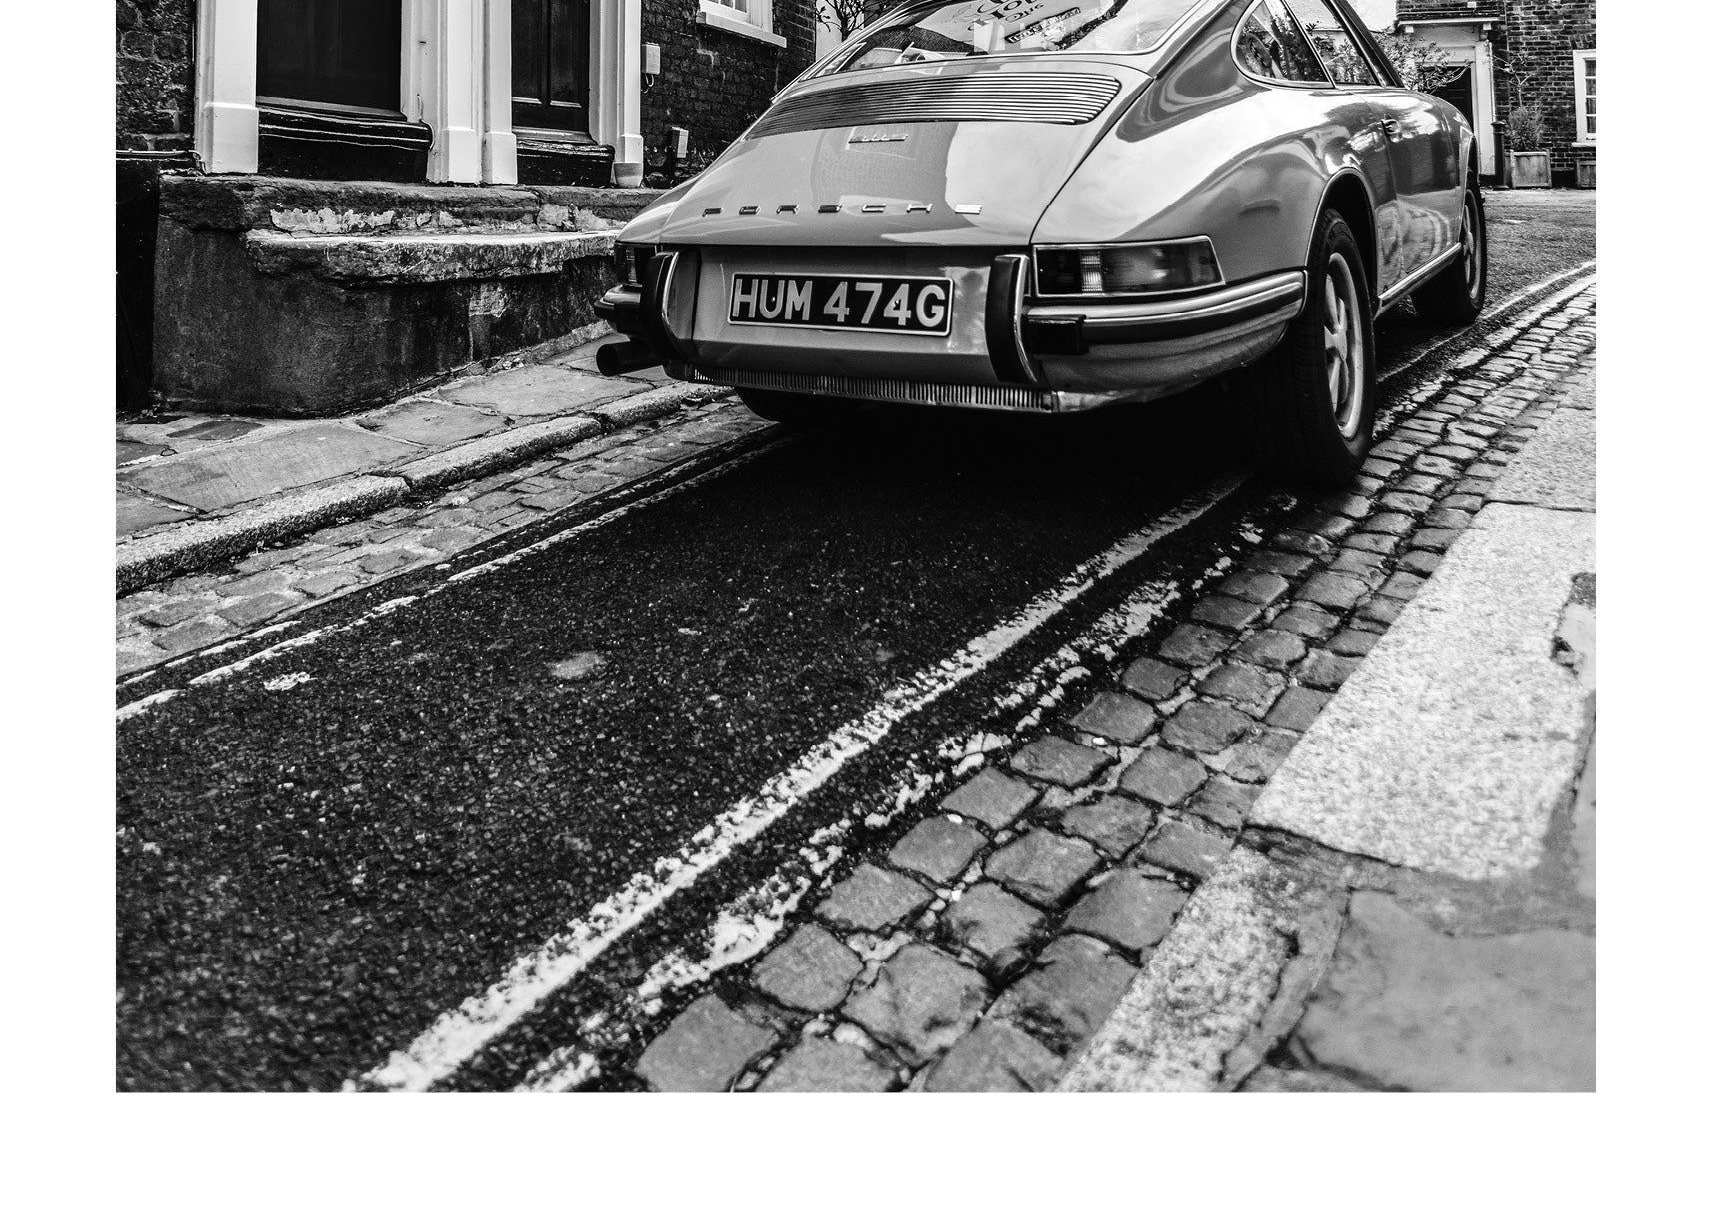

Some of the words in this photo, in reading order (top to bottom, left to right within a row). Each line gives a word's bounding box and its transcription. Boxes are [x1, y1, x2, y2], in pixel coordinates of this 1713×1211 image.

[702, 203, 983, 218] PORSCHE
[732, 277, 814, 321] HUM
[823, 281, 947, 328] 474G
